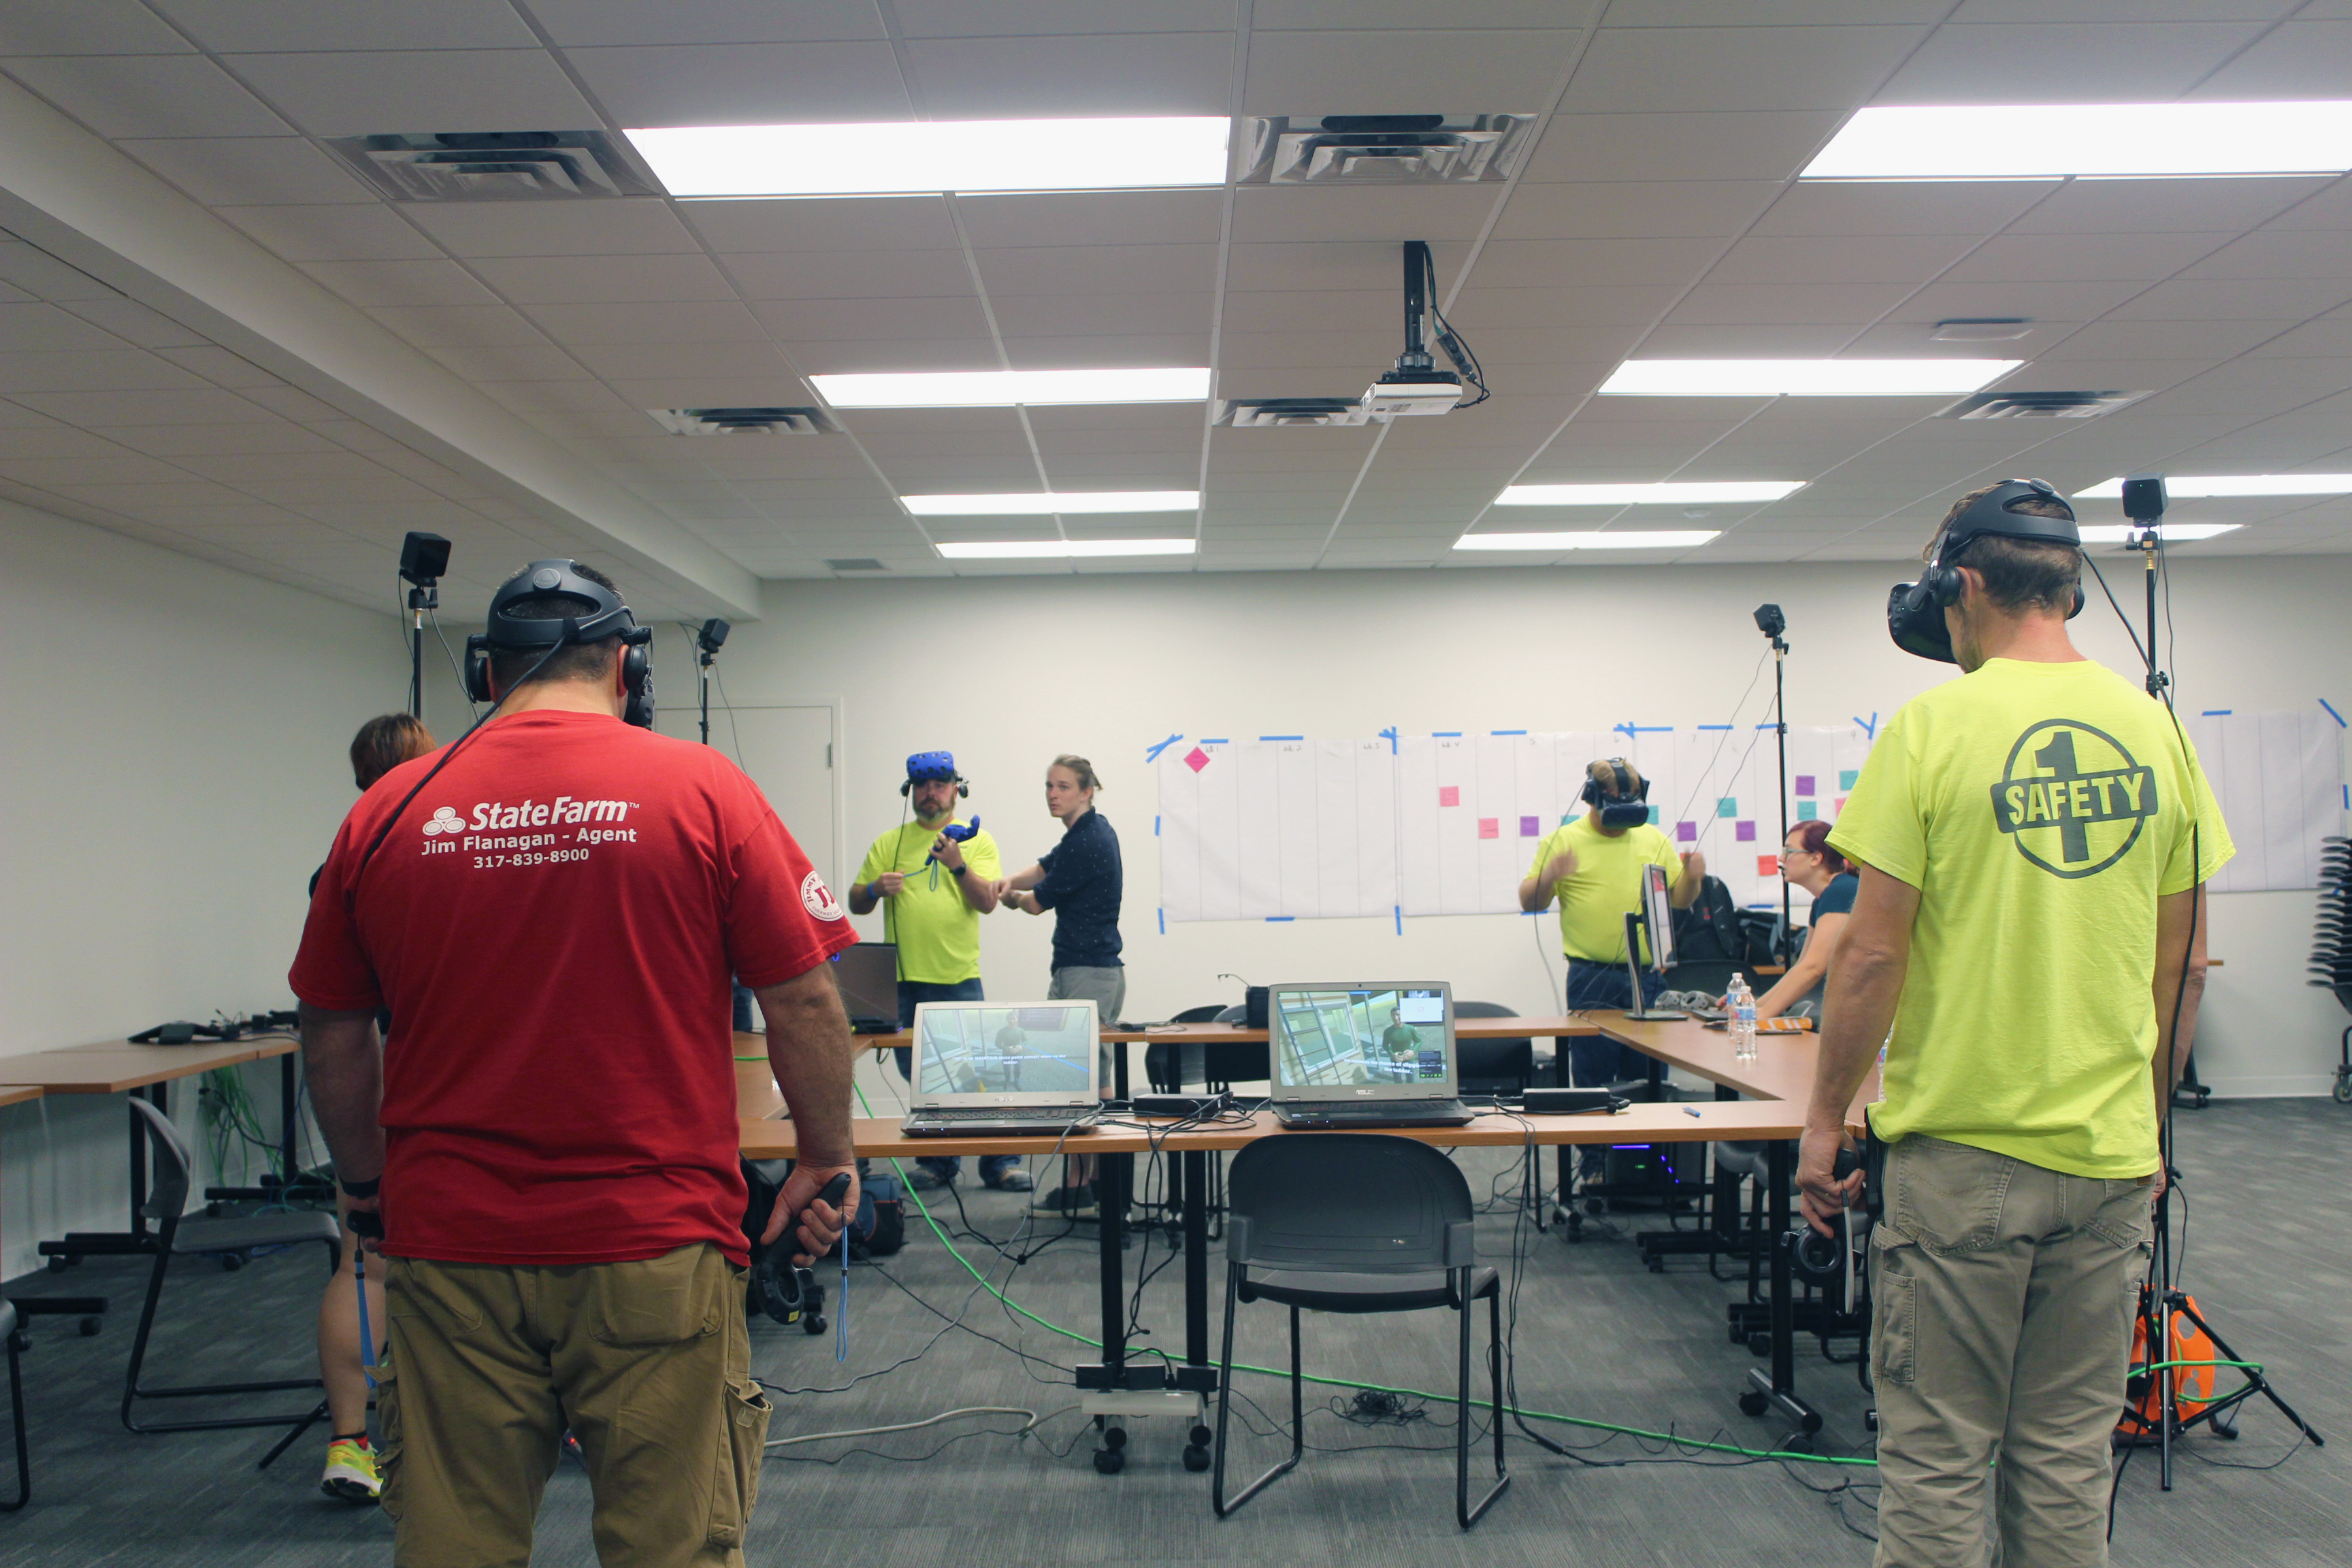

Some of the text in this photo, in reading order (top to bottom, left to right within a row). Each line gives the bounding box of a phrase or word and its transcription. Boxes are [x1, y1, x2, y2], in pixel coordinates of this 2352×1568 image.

[2005, 771, 2144, 826] SAFETY
[421, 839, 455, 855] Jim
[463, 832, 555, 851] Flanagan
[576, 827, 637, 845] Agent
[474, 848, 589, 868] 317-839-8900
[806, 877, 816, 902] JIMMY
